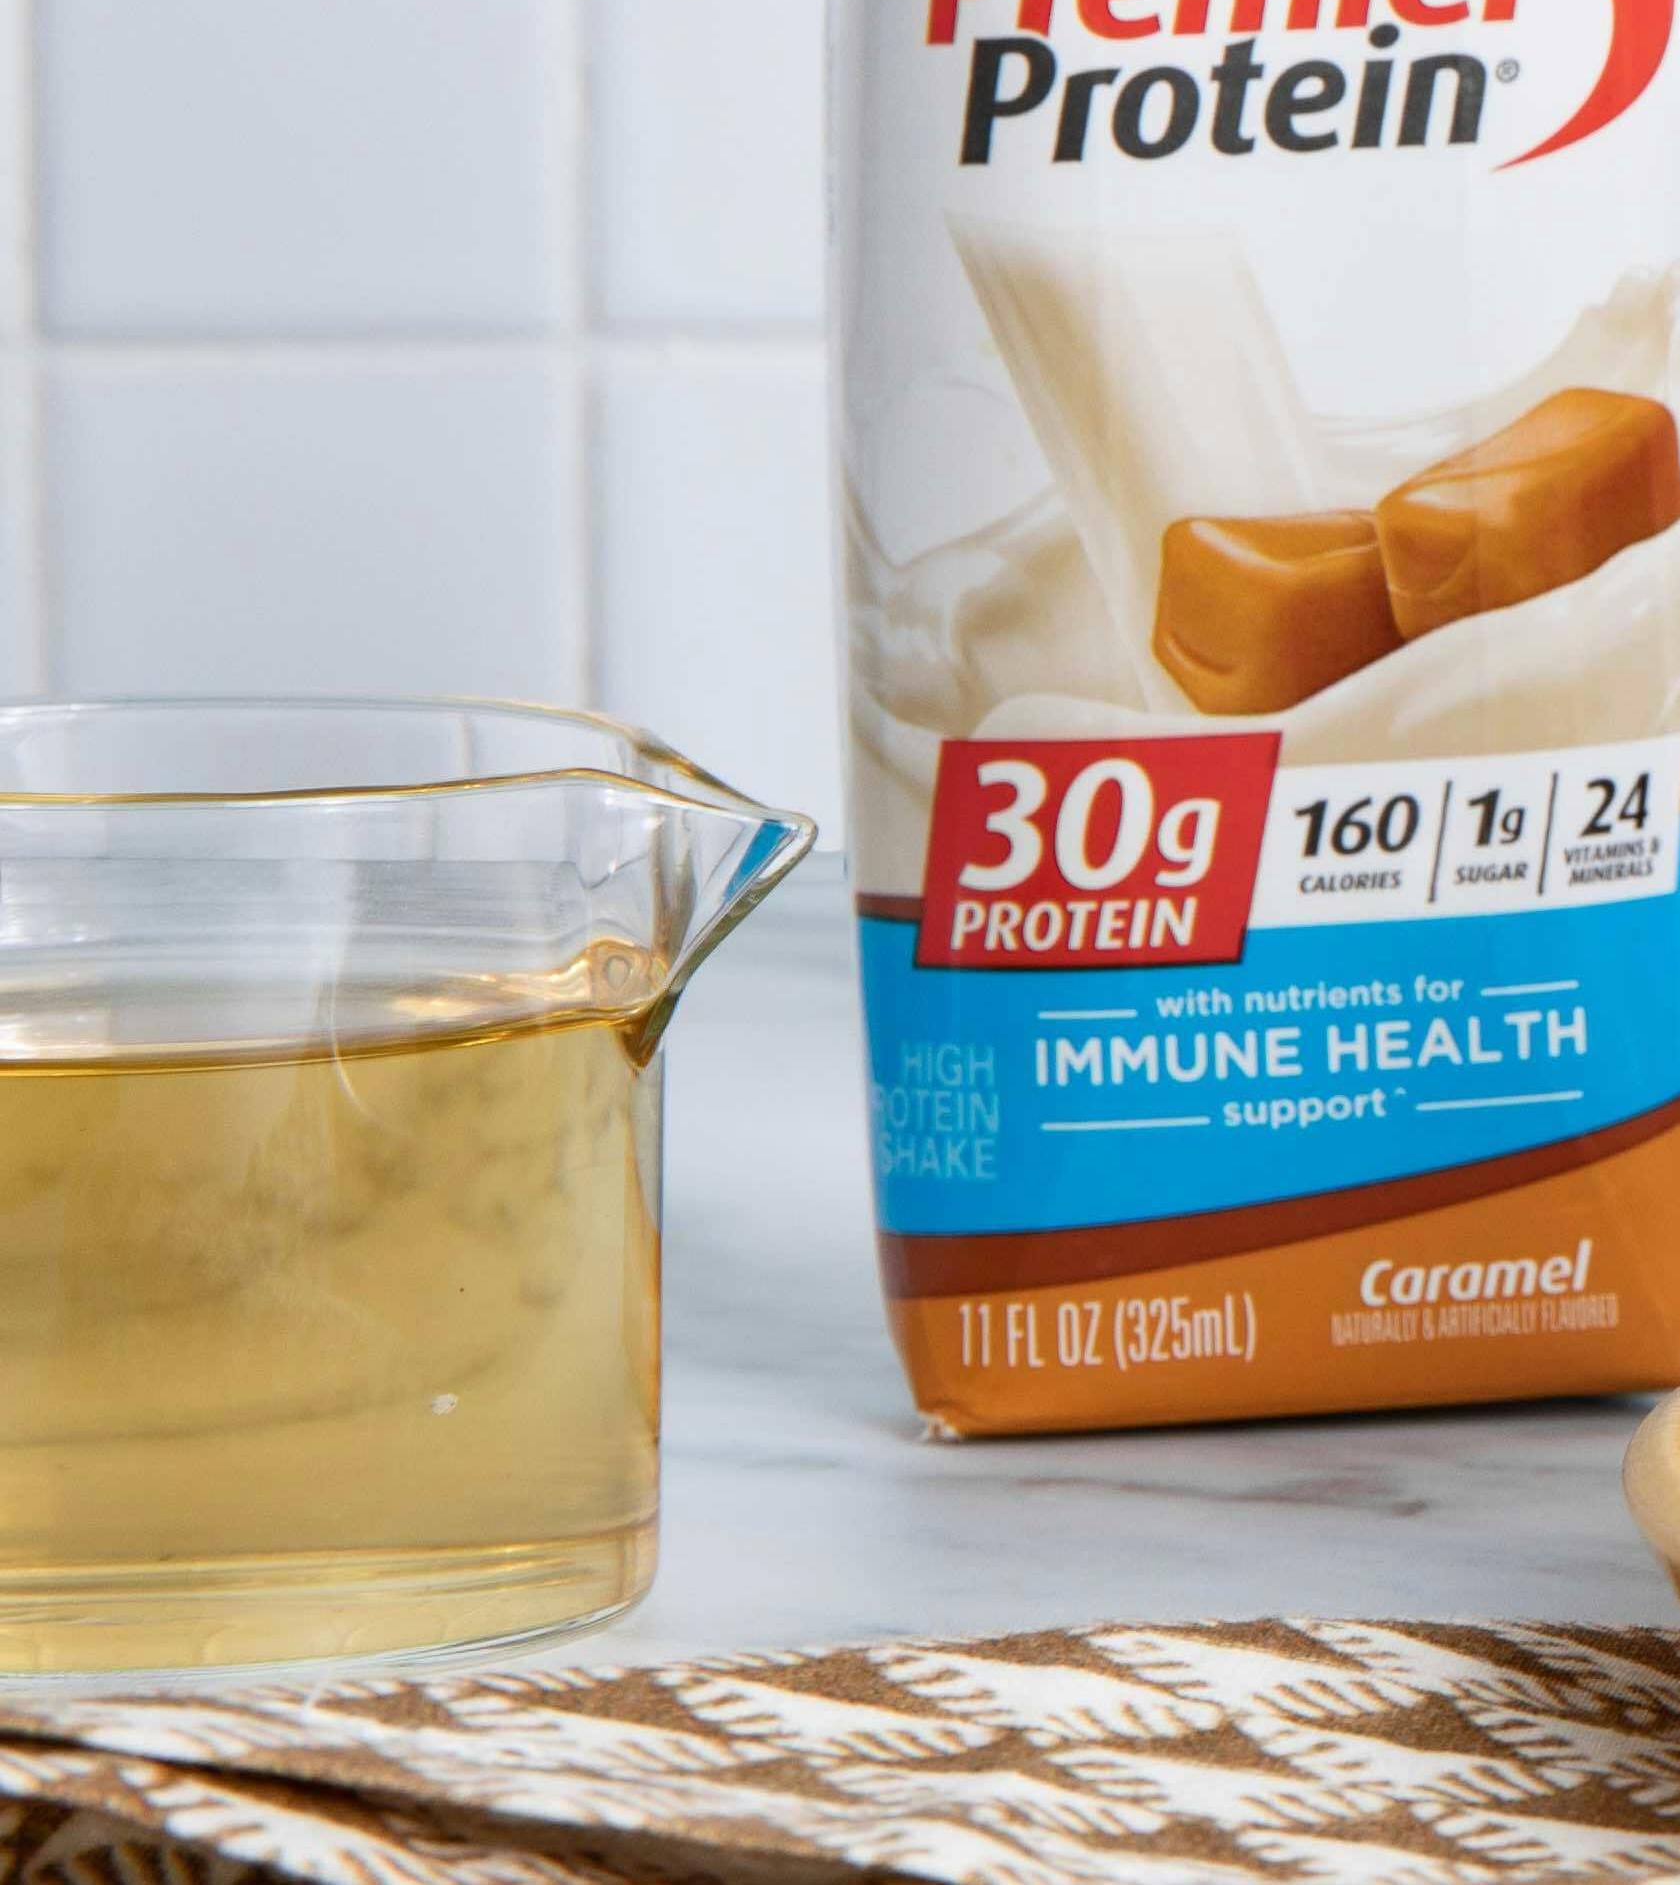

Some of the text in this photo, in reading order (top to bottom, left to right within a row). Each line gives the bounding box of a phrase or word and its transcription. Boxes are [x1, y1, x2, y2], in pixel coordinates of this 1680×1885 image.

[957, 757, 1222, 892] 30g
[1294, 794, 1420, 858] 160
[1467, 788, 1526, 847] 1g
[1579, 771, 1651, 838] 24
[1299, 869, 1403, 895] CALORIES
[1454, 861, 1528, 886] SUGAR
[950, 896, 1198, 952] PROTEIN
[1155, 974, 1464, 1018] with nutrients for
[901, 1039, 996, 1088] HIGH
[1035, 1006, 1588, 1088] IMMUNE HEALTH
[1359, 1237, 1593, 1307] Caramel
[959, 1291, 1257, 1372] 11 FL OZ (325mL)
